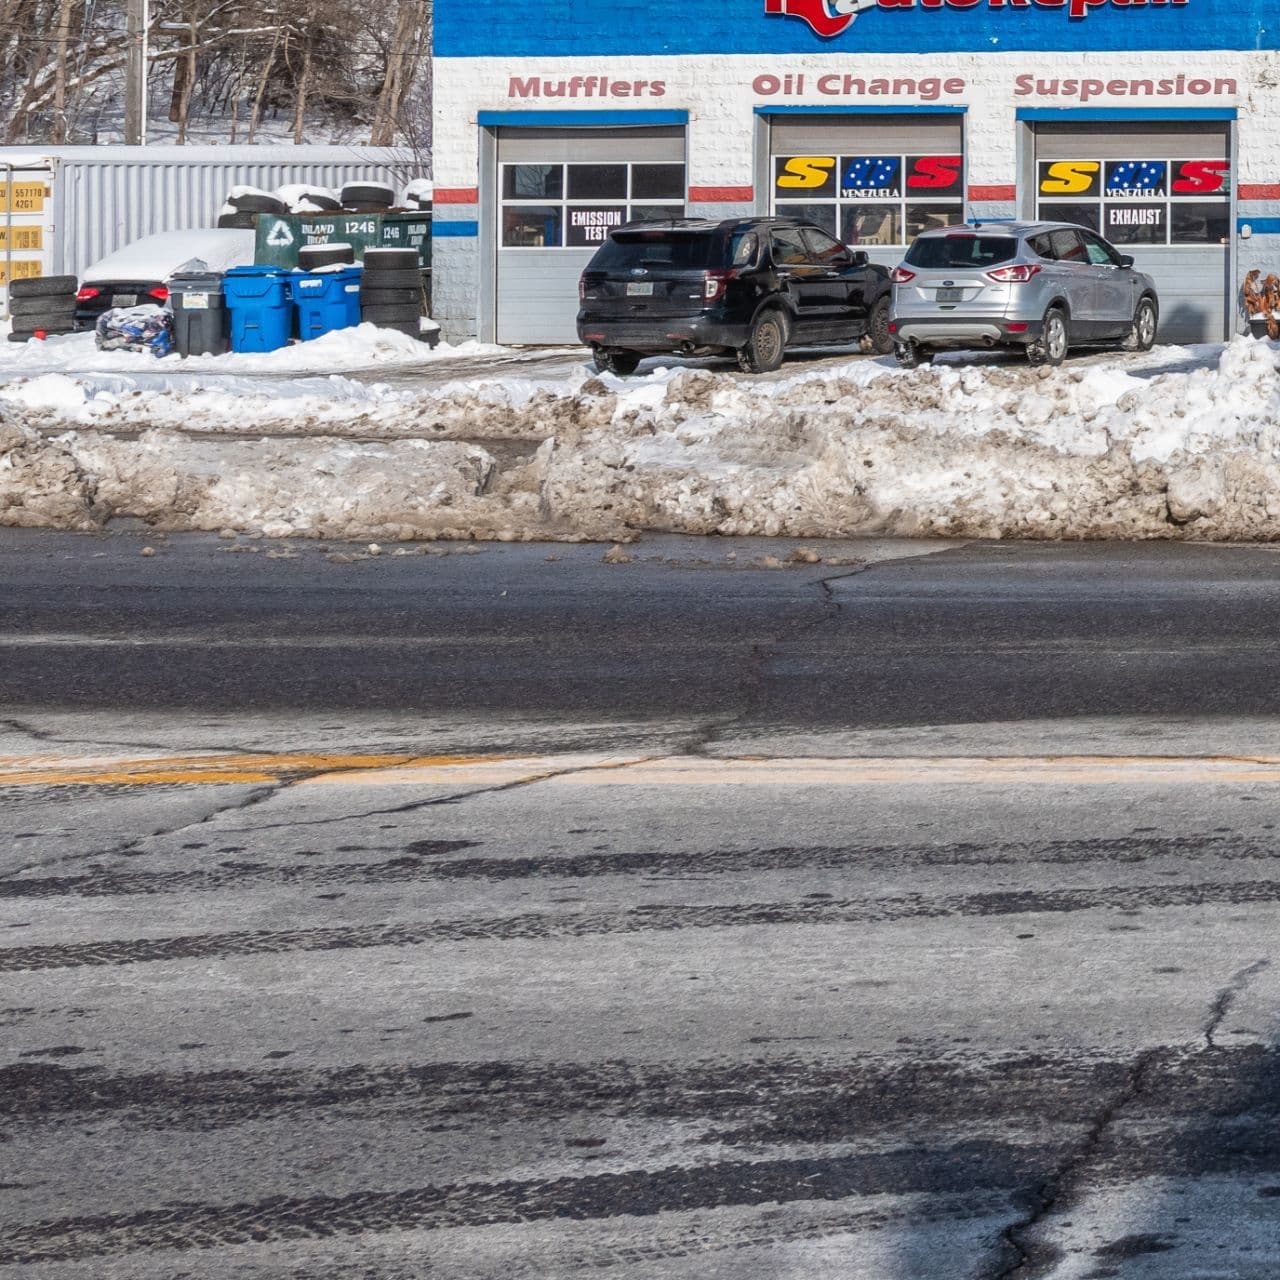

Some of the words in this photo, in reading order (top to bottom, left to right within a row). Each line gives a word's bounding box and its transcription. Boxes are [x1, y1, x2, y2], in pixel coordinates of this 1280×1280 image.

[508, 76, 666, 99] Mufflers
[752, 74, 804, 96] Oil
[817, 74, 966, 101] Change
[1014, 74, 1237, 102] Suspension
[842, 189, 900, 198] VENEZUELA
[1106, 188, 1166, 197] VENEZUELA
[571, 211, 621, 226] EMISSION
[1110, 209, 1161, 225] EXHAUST
[345, 221, 375, 234] 1246
[584, 226, 608, 241] TEST
